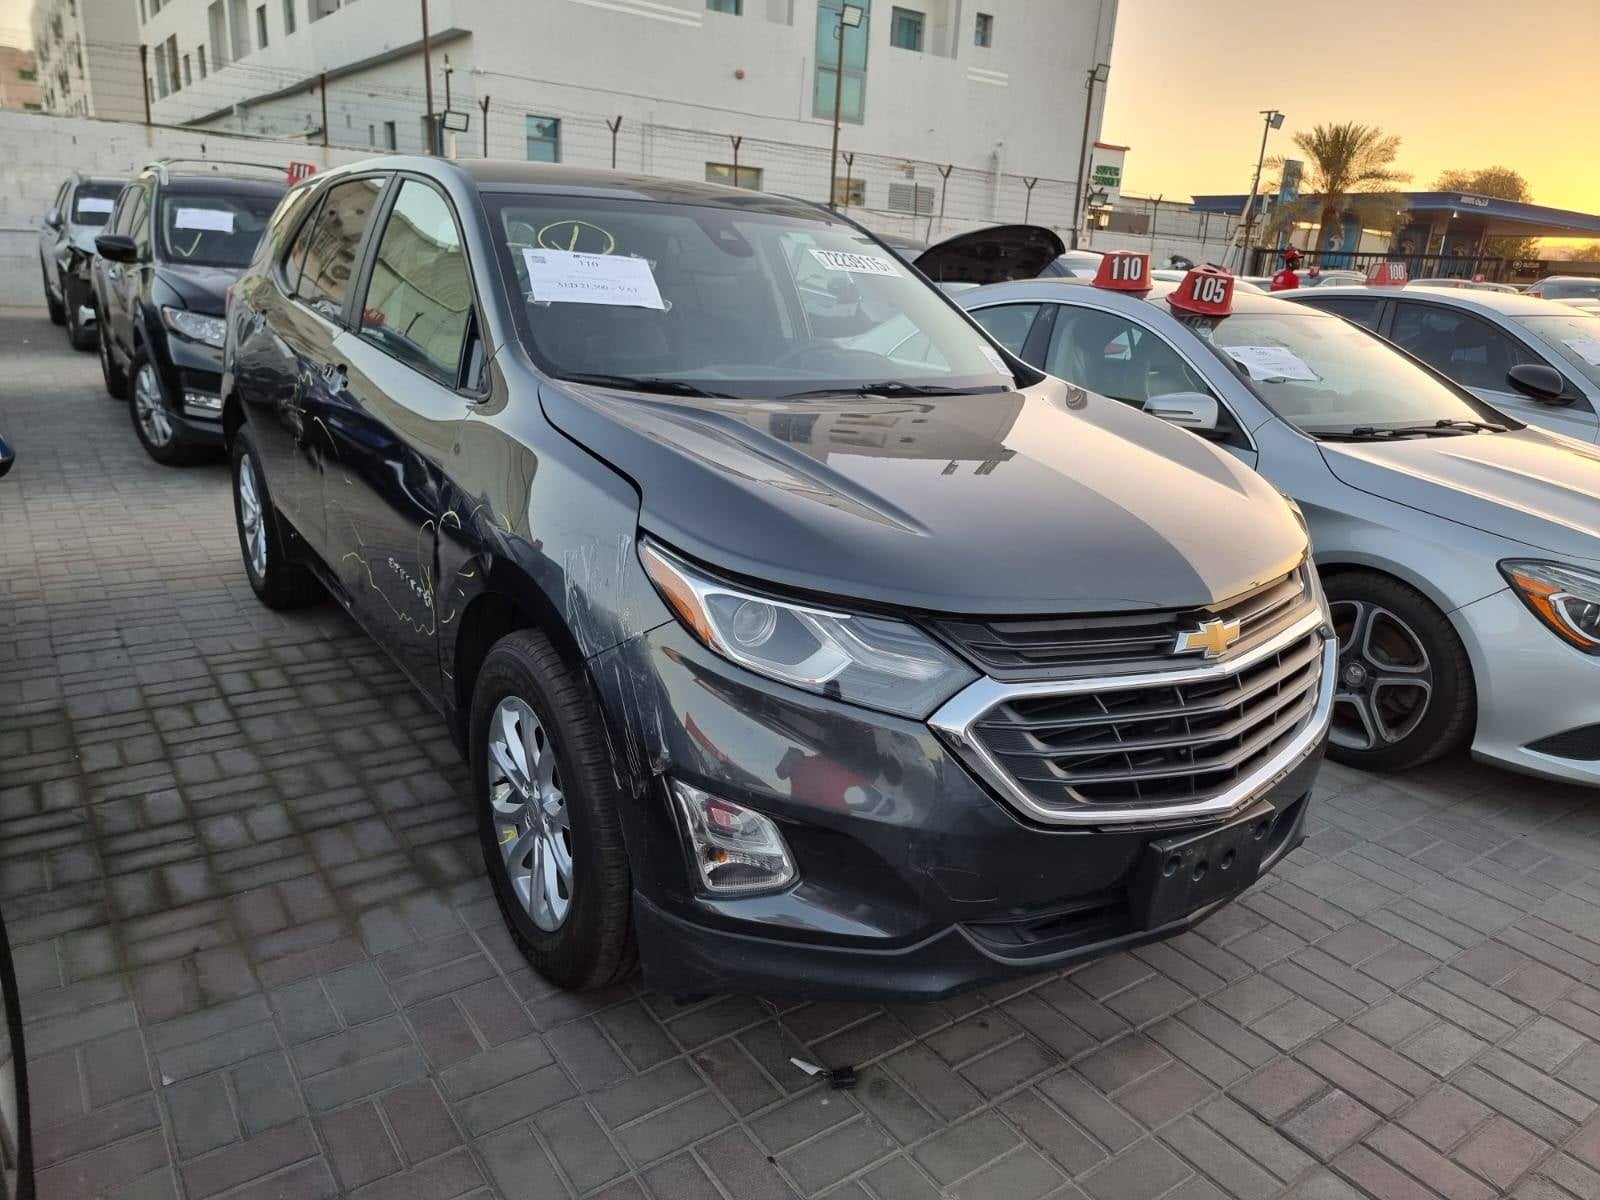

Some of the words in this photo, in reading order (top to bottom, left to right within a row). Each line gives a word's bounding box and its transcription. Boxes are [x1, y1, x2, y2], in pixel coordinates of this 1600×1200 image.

[1112, 256, 1141, 281] 110
[1389, 263, 1405, 280] 100
[1192, 277, 1228, 304] 105
